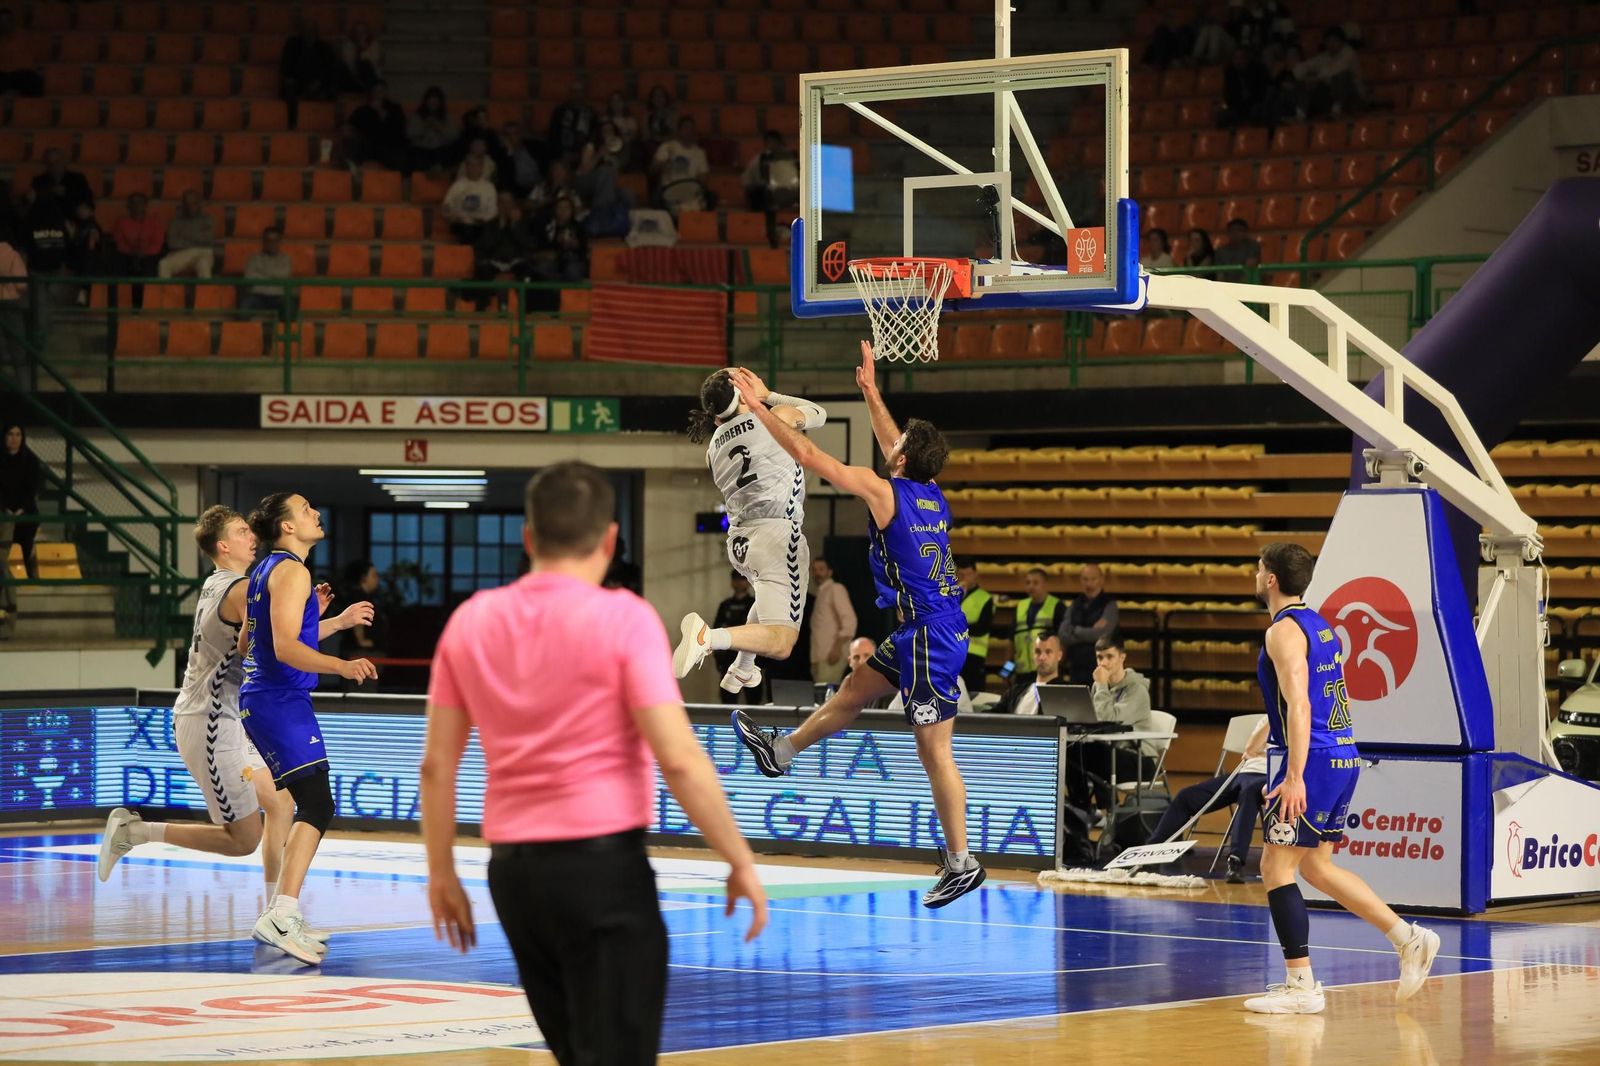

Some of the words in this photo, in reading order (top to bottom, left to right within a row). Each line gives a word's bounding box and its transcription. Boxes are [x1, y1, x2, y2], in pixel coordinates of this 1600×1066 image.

[267, 400, 371, 424] SAIDA
[381, 401, 397, 424] E
[415, 400, 541, 425] ASEOS
[715, 419, 755, 450] ROBERTS
[728, 444, 758, 489] 2
[1332, 834, 1445, 861] Paradelo
